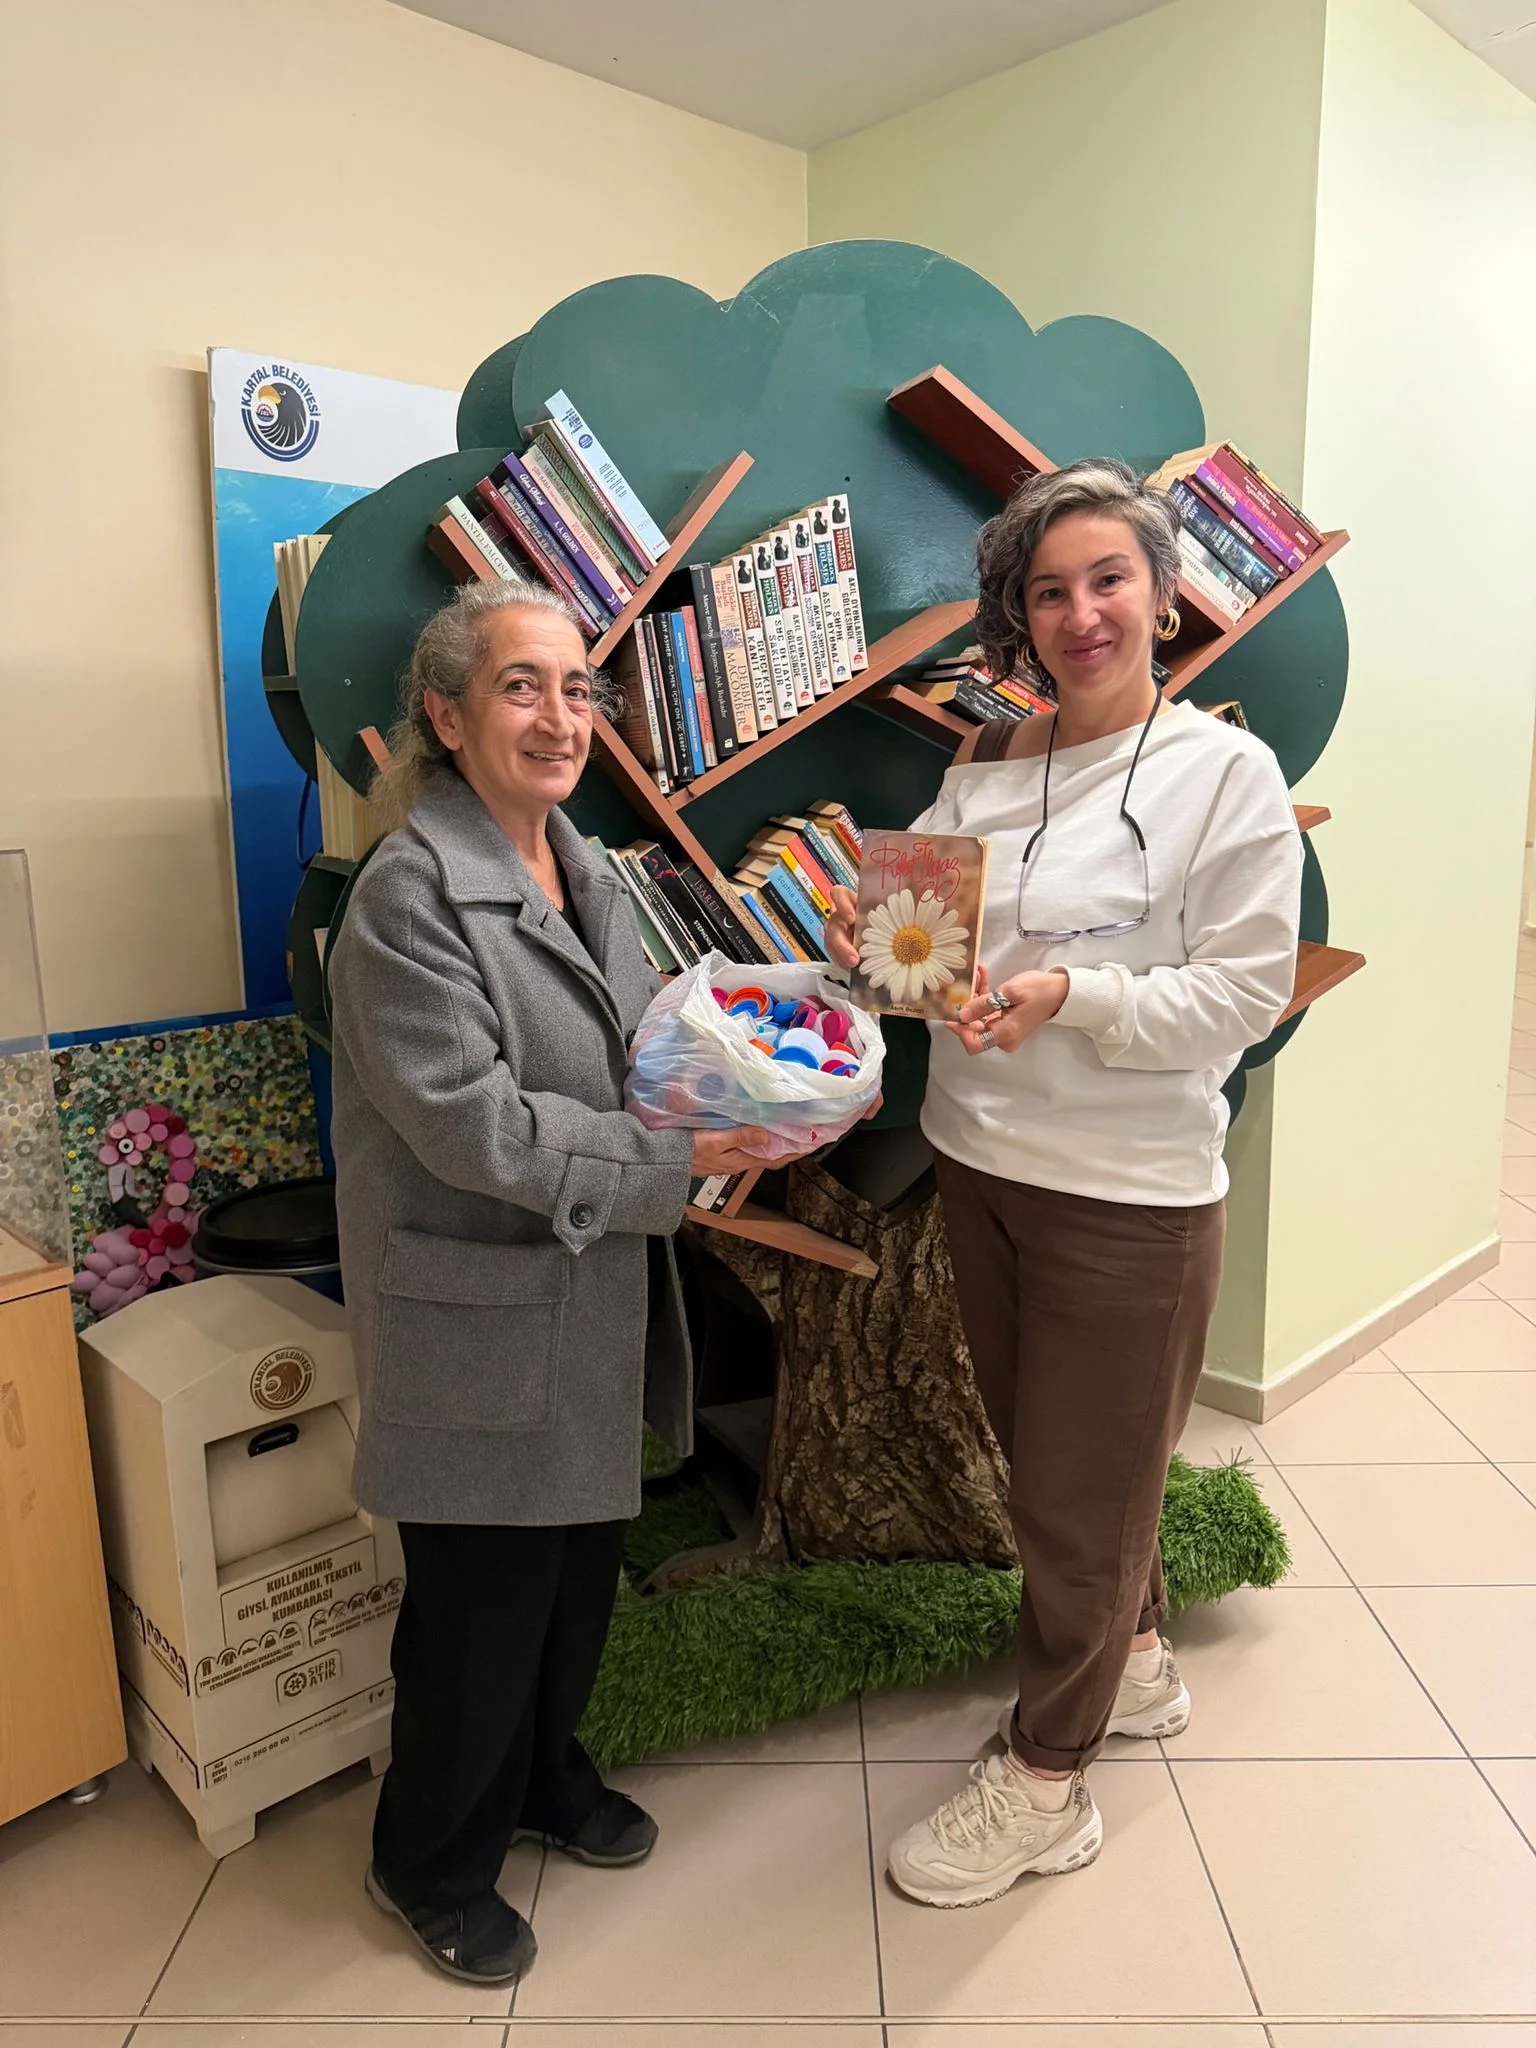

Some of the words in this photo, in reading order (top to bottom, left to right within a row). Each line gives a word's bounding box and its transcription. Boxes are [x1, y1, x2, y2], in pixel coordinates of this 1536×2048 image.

[241, 366, 270, 407] KARTAL
[272, 364, 321, 416] BELEDİYESİ
[817, 544, 831, 584] HOLMES
[824, 542, 836, 583] SHERLOCK
[835, 529, 847, 570] HOLMES
[762, 579, 773, 614] HOLMES
[847, 576, 856, 595] AKIL
[743, 592, 754, 628] HOLMES
[812, 604, 822, 630] AKLIN
[821, 590, 831, 617] ASLA
[792, 613, 800, 632] AKIL
[747, 635, 759, 672] KANIT
[769, 634, 782, 686] SAKLIDIR
[727, 650, 745, 724] MACOMBER
[738, 663, 752, 709] DEBBIE
[779, 647, 792, 697] DETAYDA
[838, 812, 861, 840] OSMAN
[775, 874, 796, 899] Sophie
[793, 898, 815, 925] Kinsella
[254, 1359, 275, 1389] KARTAL
[237, 1598, 269, 1621] GİYSİ,
[324, 1561, 362, 1585] TEKSTİL
[266, 1558, 333, 1593] KULLANILMIŞ
[272, 1588, 333, 1622] KUMBARASI
[308, 1658, 336, 1677] SIFIR
[310, 1667, 337, 1687] ATIK
[234, 1755, 251, 1767] 0216
[280, 1735, 290, 1745] 60
